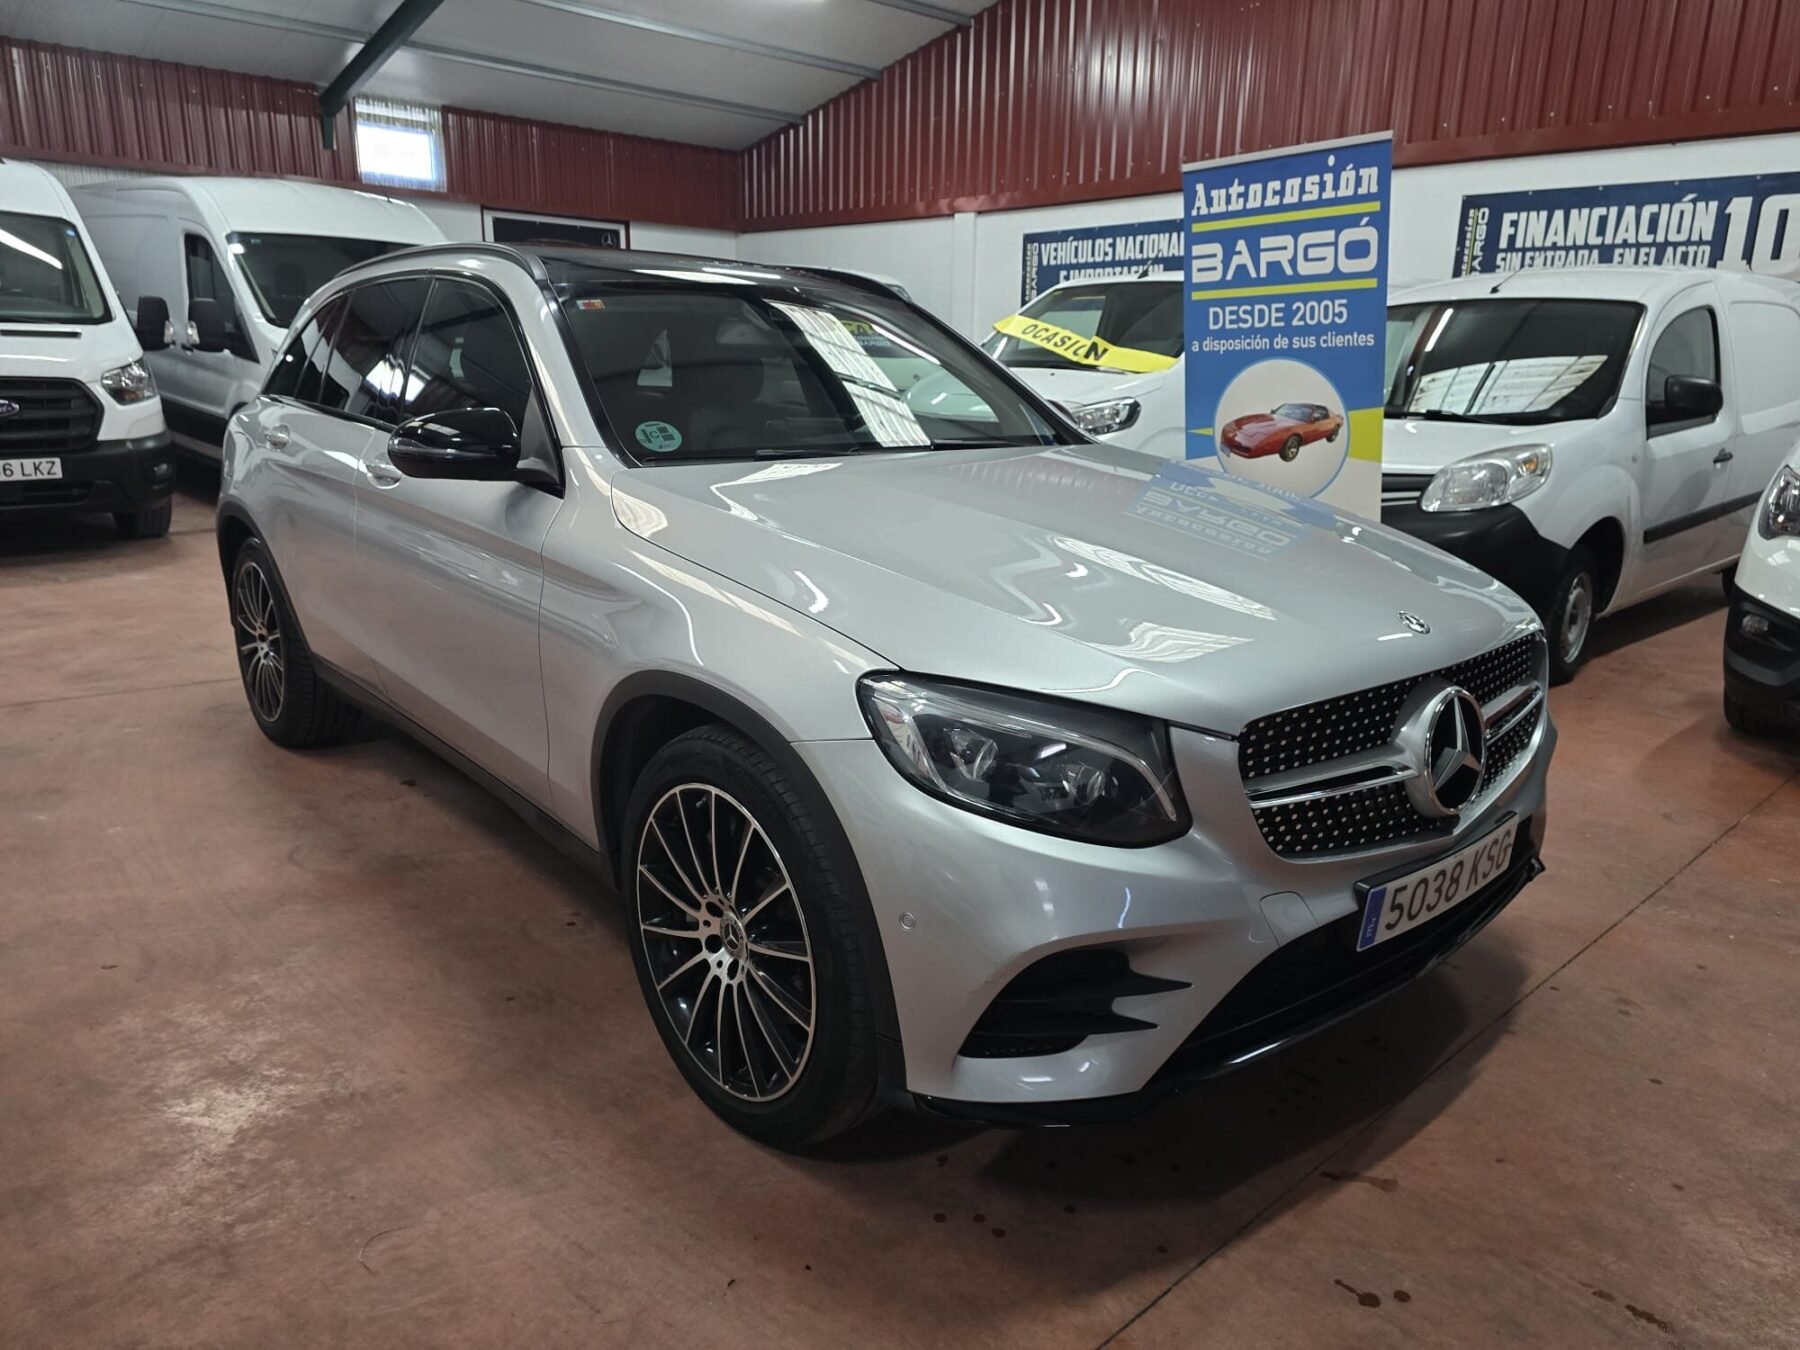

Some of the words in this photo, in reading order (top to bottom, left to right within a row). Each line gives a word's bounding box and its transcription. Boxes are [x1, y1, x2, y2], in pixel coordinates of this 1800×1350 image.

[1191, 154, 1379, 217] Autocasión
[1498, 193, 1719, 249] FINANCIACIÓN
[1040, 236, 1113, 266] VEHÍCULOS
[1191, 216, 1379, 284] BARGÓ
[1495, 252, 1523, 273] SIN
[1209, 303, 1285, 330] DESDE
[1291, 299, 1348, 327] 2005
[1191, 340, 1199, 352] a
[1203, 336, 1270, 355] disposición
[1273, 334, 1289, 349] de
[1292, 335, 1317, 349] sus
[1319, 331, 1375, 348] clientes
[20, 460, 58, 477] LKZ
[1384, 859, 1465, 931] 5038
[1465, 829, 1513, 892] KSG
